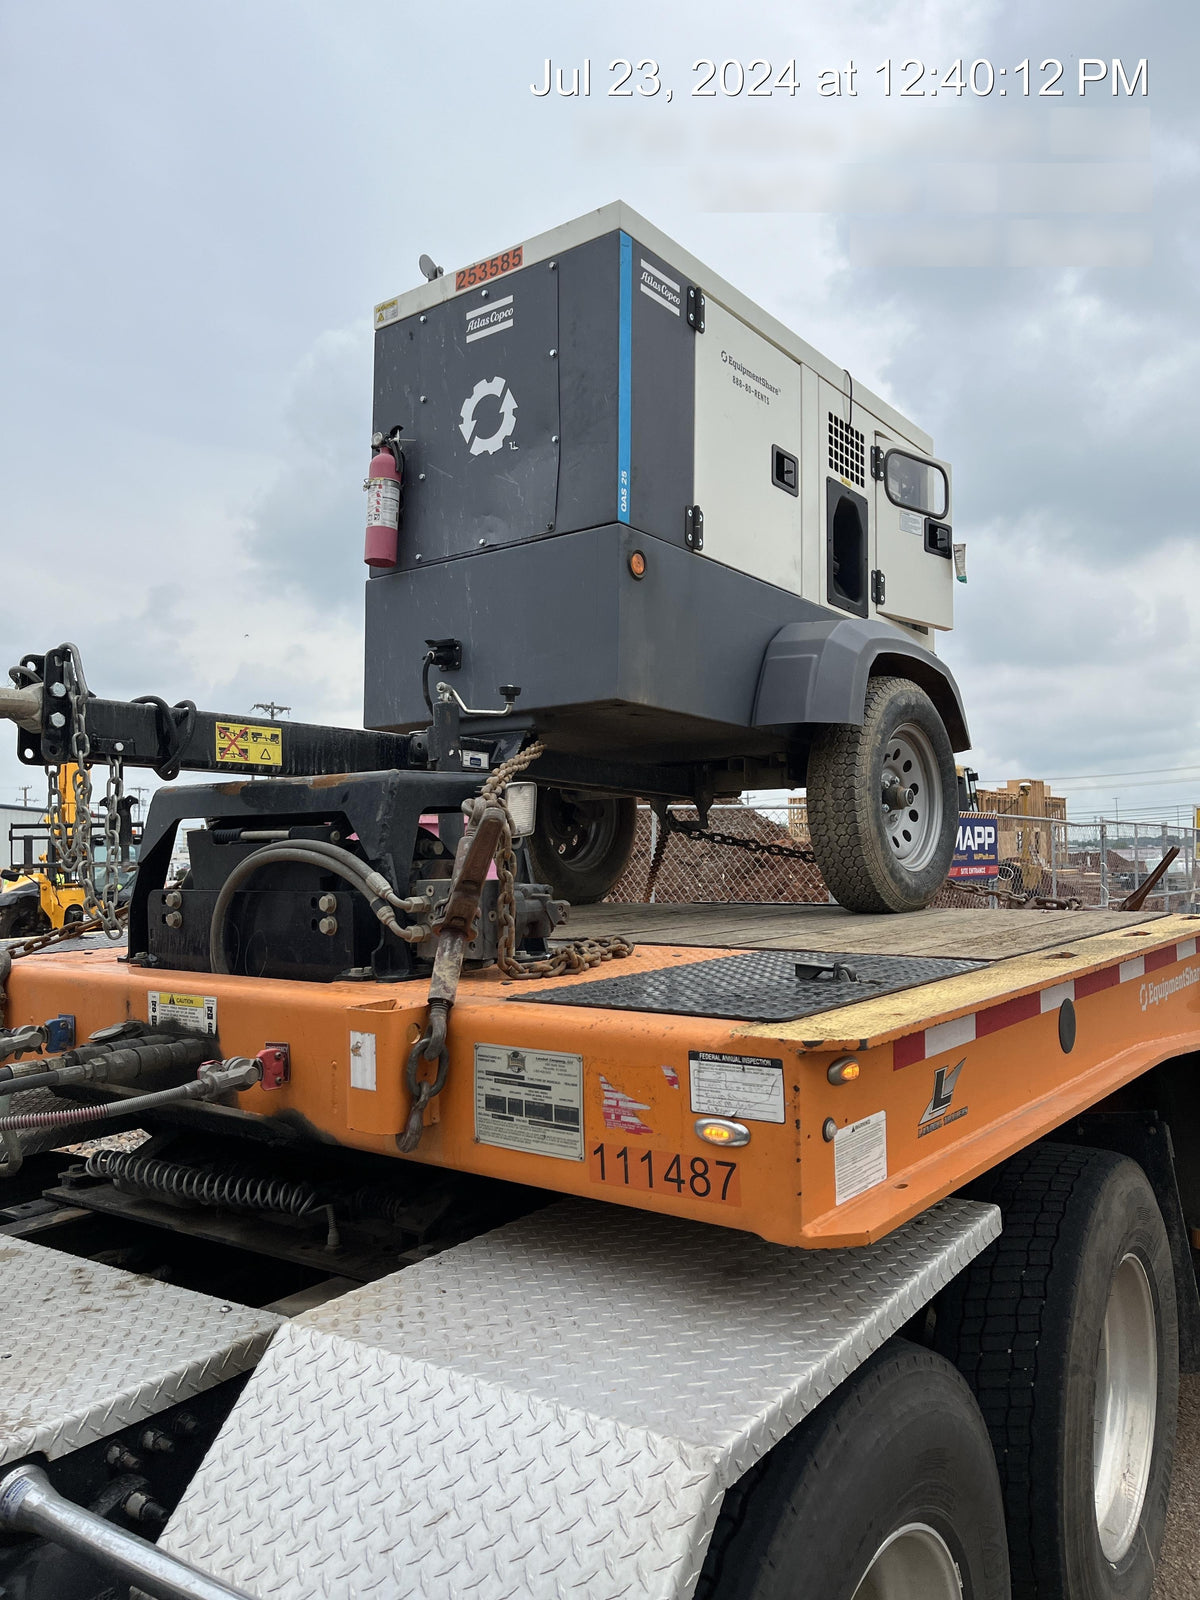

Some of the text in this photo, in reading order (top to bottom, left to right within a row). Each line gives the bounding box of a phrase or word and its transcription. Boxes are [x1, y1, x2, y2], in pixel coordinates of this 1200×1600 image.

[457, 246, 522, 290] 253585
[640, 271, 681, 305] Atlas Copco
[466, 307, 514, 333] Atlas Copco
[728, 355, 779, 396] EquipmentShare
[620, 470, 628, 486] 25
[176, 997, 194, 1005] CAUTION
[699, 1052, 772, 1066] FEDERAL ANNUAL INSPECTION
[593, 1143, 737, 1201] 111487
